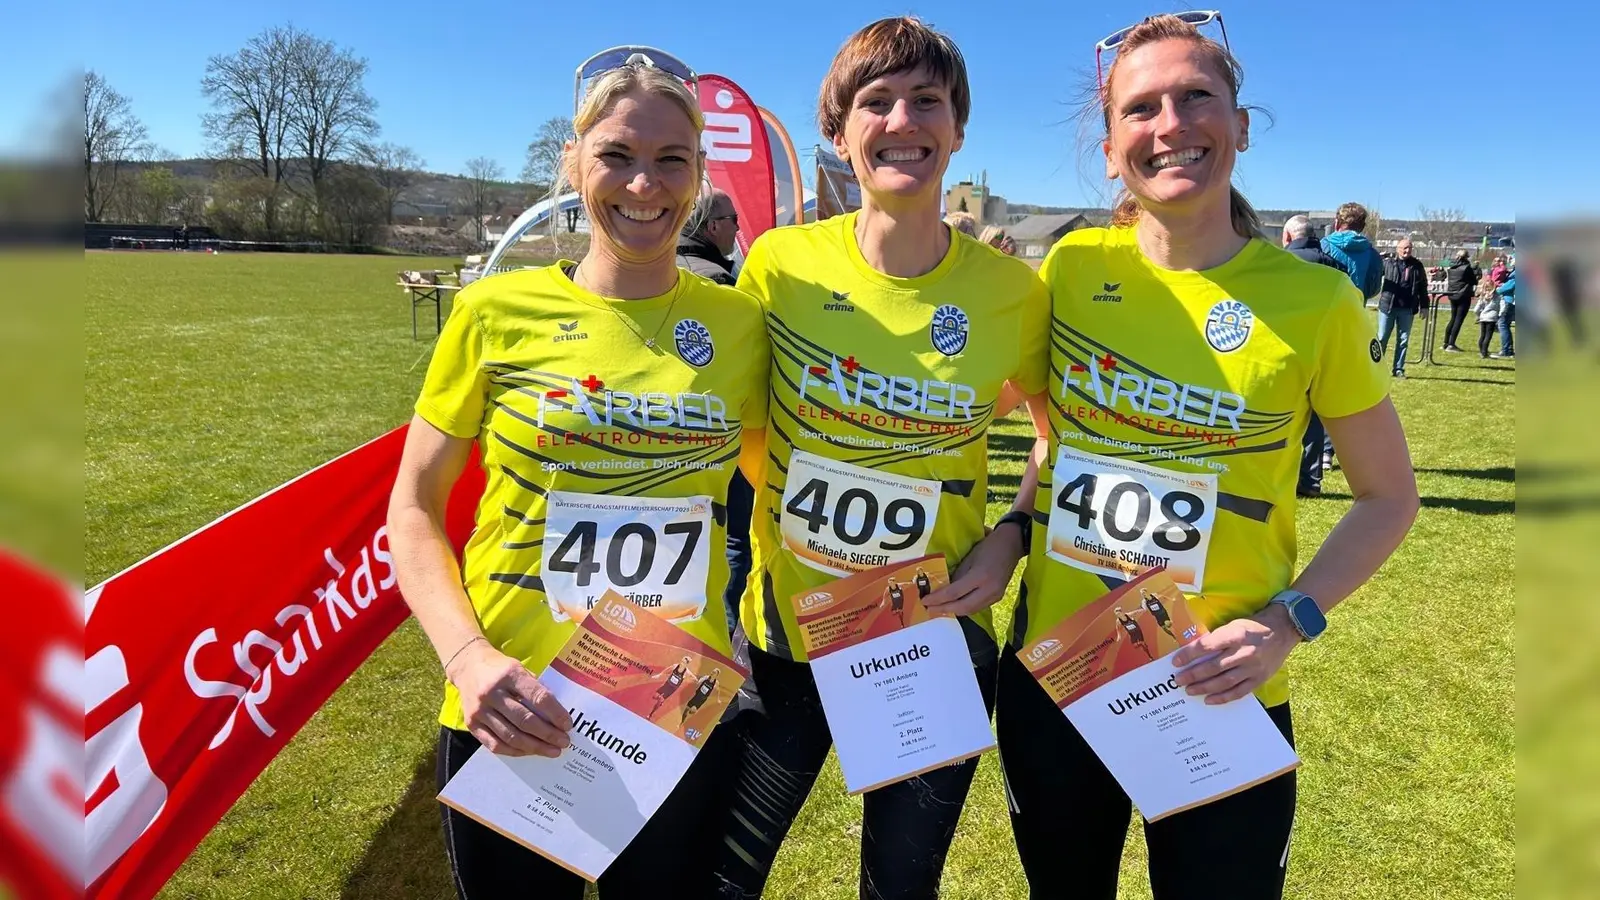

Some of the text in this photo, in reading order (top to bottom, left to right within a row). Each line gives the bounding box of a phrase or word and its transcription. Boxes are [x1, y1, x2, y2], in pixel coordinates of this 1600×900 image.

[824, 302, 854, 312] erima
[1092, 294, 1122, 302] erima
[933, 306, 968, 325] TV 1861
[1209, 302, 1224, 318] TV
[552, 332, 588, 342] erima
[675, 320, 709, 338] TV 1861
[798, 404, 972, 437] ELEKTROTECHNIK
[537, 432, 728, 448] ELEKTROTECHNIK
[798, 429, 828, 441] Sport
[830, 432, 890, 449] verbindet.
[893, 442, 920, 453] Dich
[922, 447, 943, 456] und
[1062, 430, 1084, 441] port
[1086, 434, 1146, 454] verbindet.
[1148, 446, 1176, 460] Dich
[1179, 454, 1204, 469] und
[541, 460, 576, 472] Sport
[581, 459, 649, 470] verbindet.
[653, 459, 682, 470] Dich
[685, 461, 707, 471] und
[786, 478, 926, 550] 409
[1057, 473, 1204, 551] 408
[549, 520, 702, 587] 407
[807, 539, 889, 566] Michaela SIEGERT
[1074, 536, 1170, 569] Christine SCHARDT
[806, 615, 842, 630] Bayerische
[570, 649, 581, 658] am
[576, 640, 628, 672] Meisterschaften
[582, 632, 653, 676] Bayerische Langstaffel
[850, 644, 931, 679] Urkunde
[572, 658, 617, 687] Marktheidenfeld
[895, 670, 917, 682] Amberg
[1044, 658, 1080, 682] Bayerische
[1048, 654, 1100, 686] Meisterschaften
[1107, 674, 1180, 716] Urkund
[1162, 698, 1185, 711] Amberg
[906, 726, 923, 735] Platz
[591, 756, 614, 772] Amberg
[1191, 750, 1209, 761] Platz
[534, 796, 561, 814] 2. Platz
